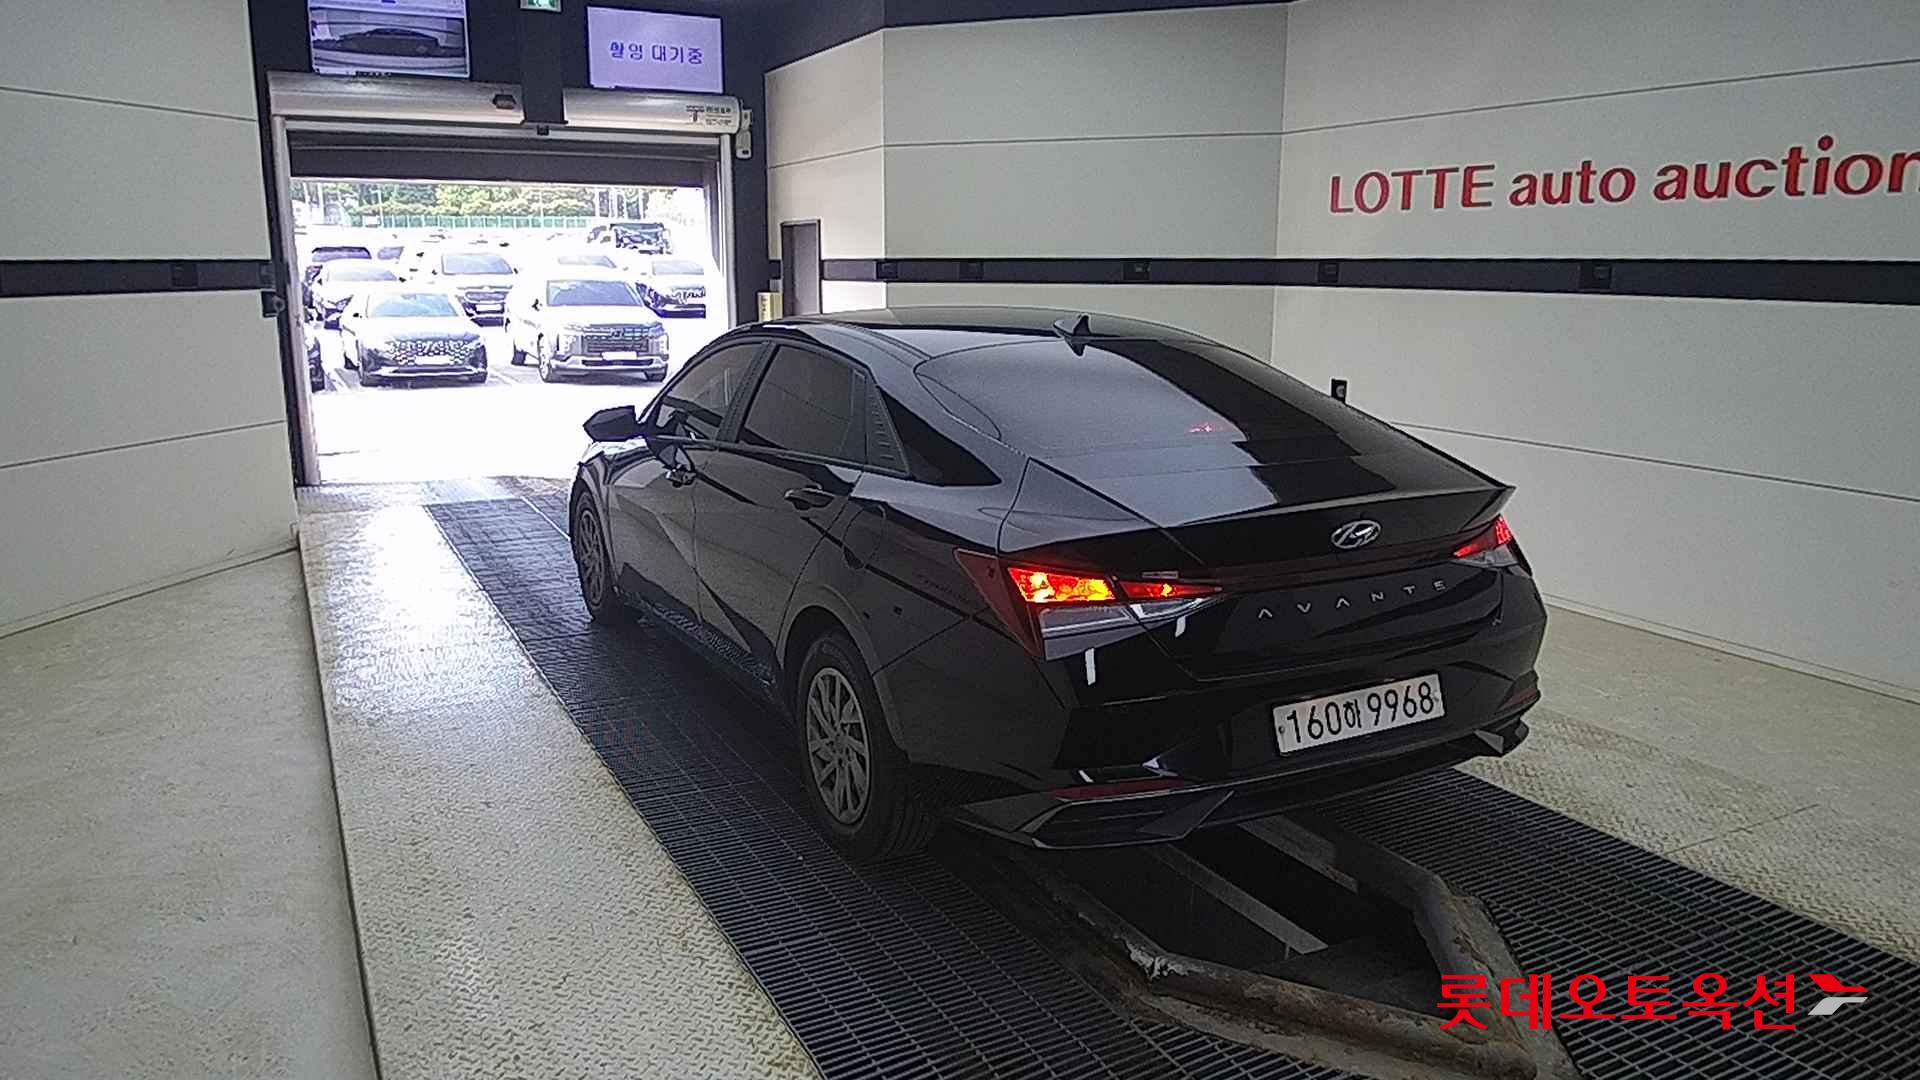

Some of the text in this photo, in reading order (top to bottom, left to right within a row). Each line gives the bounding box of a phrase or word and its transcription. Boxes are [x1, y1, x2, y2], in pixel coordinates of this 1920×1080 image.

[651, 44, 702, 65] 대기중
[1329, 164, 1496, 214] LOTTE
[1509, 160, 1636, 206] auto
[1258, 580, 1447, 619] AVANTE
